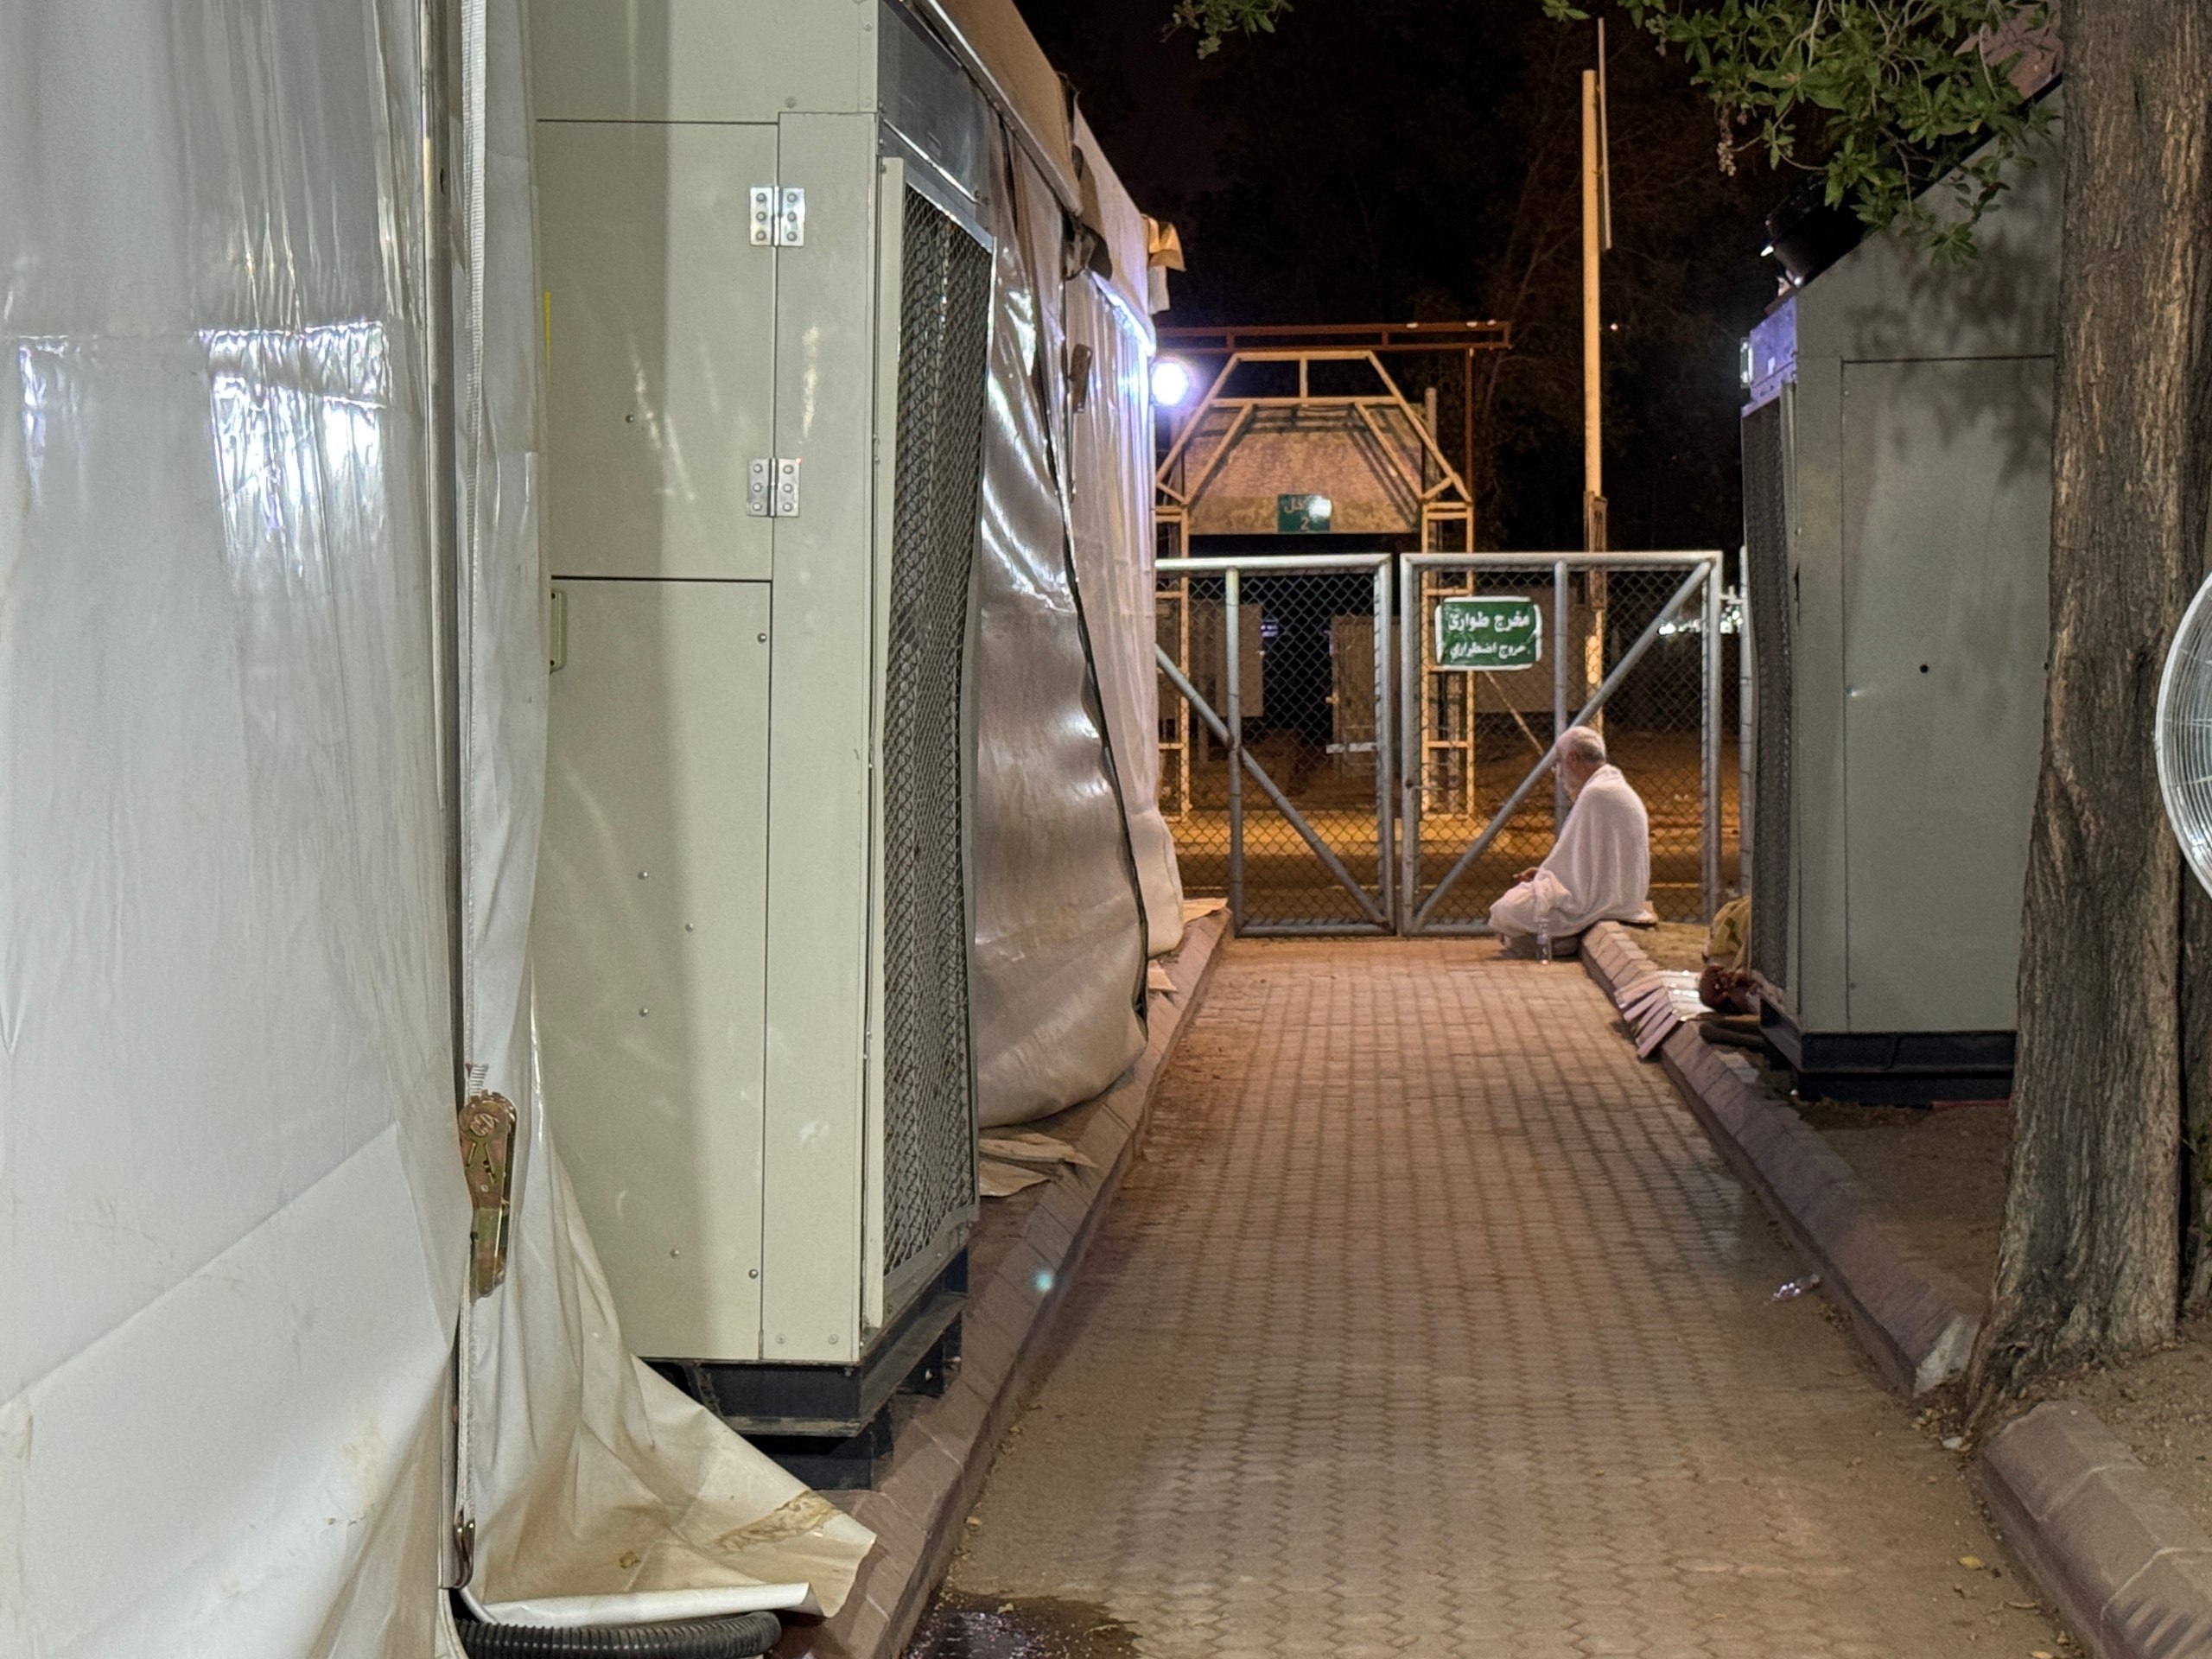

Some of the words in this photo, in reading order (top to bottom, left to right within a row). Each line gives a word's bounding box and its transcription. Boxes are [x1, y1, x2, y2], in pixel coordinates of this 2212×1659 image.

[1300, 516, 1309, 531] 2
[1448, 611, 1491, 632] طوارئ
[1494, 610, 1530, 632] مخرج
